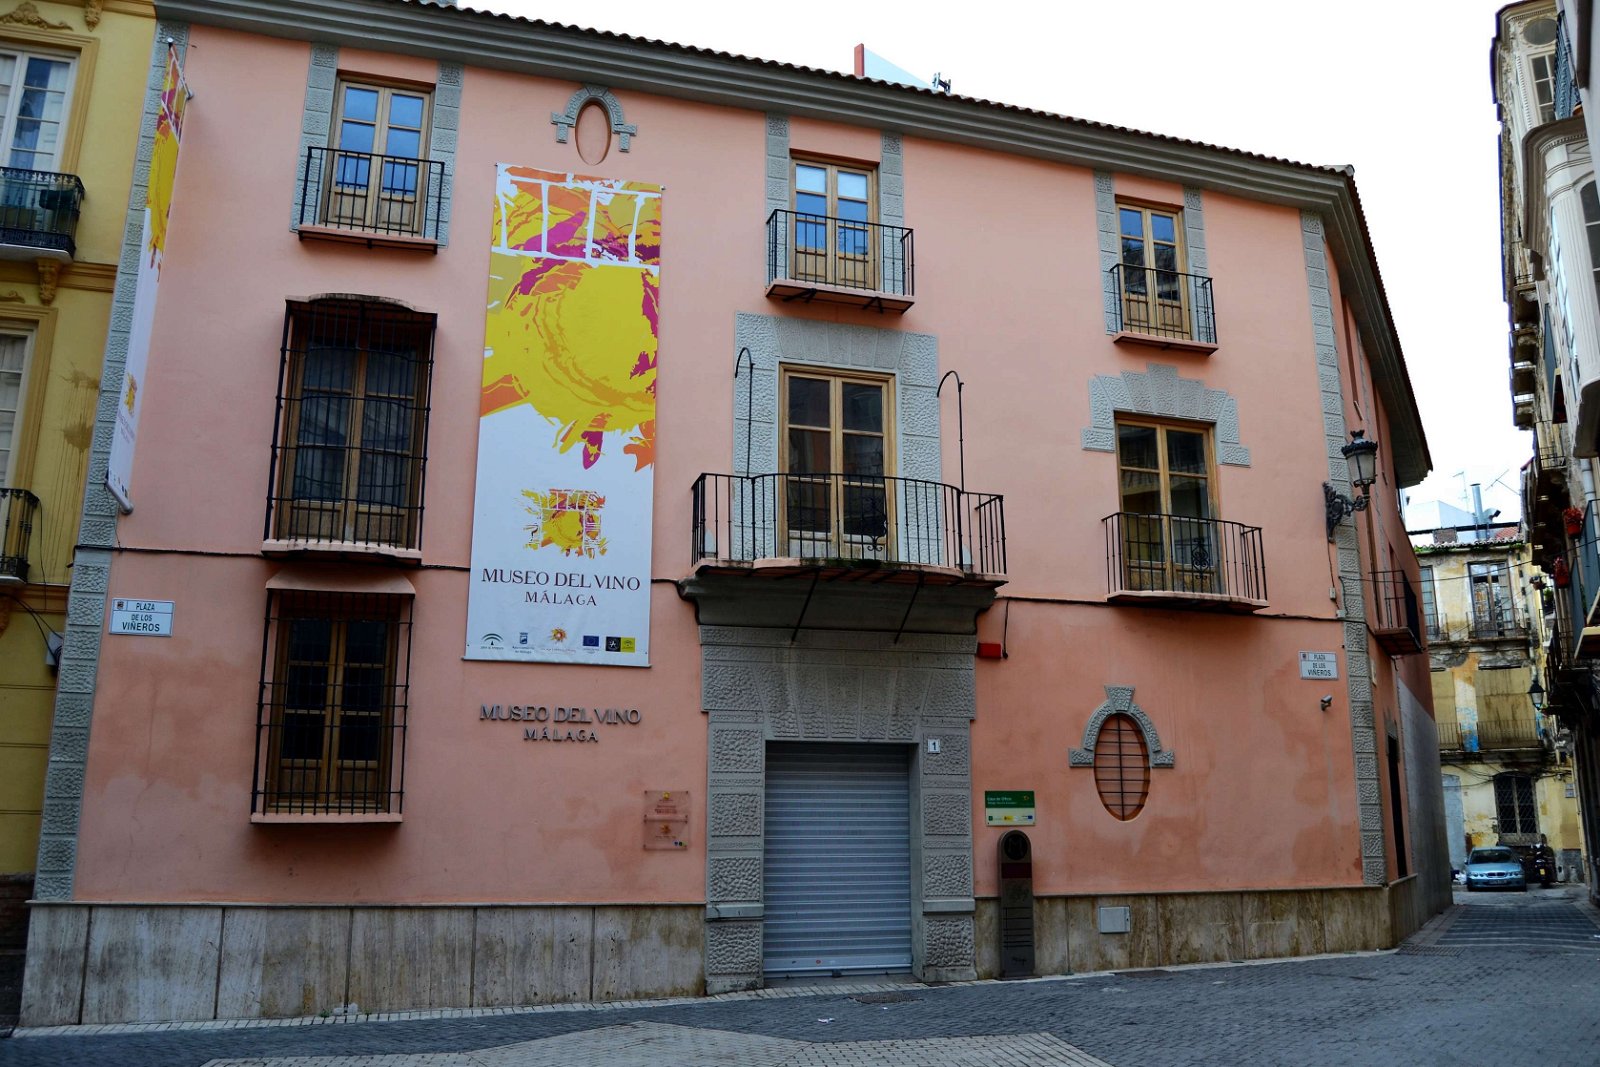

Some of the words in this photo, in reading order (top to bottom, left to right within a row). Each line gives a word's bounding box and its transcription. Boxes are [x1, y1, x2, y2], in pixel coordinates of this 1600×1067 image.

[481, 568, 550, 586] MUSEO
[554, 572, 592, 588] DEL
[594, 574, 641, 591] VINO
[525, 590, 597, 606] MÁLAGA
[135, 602, 155, 611] PLAZA
[140, 614, 153, 622] LOS
[122, 621, 160, 632] VIÑEROS
[479, 703, 550, 722] MUSEO
[553, 706, 592, 724] DEL
[594, 708, 642, 725] VINO
[523, 726, 598, 743] MÁLAGA
[931, 741, 937, 750] 1
